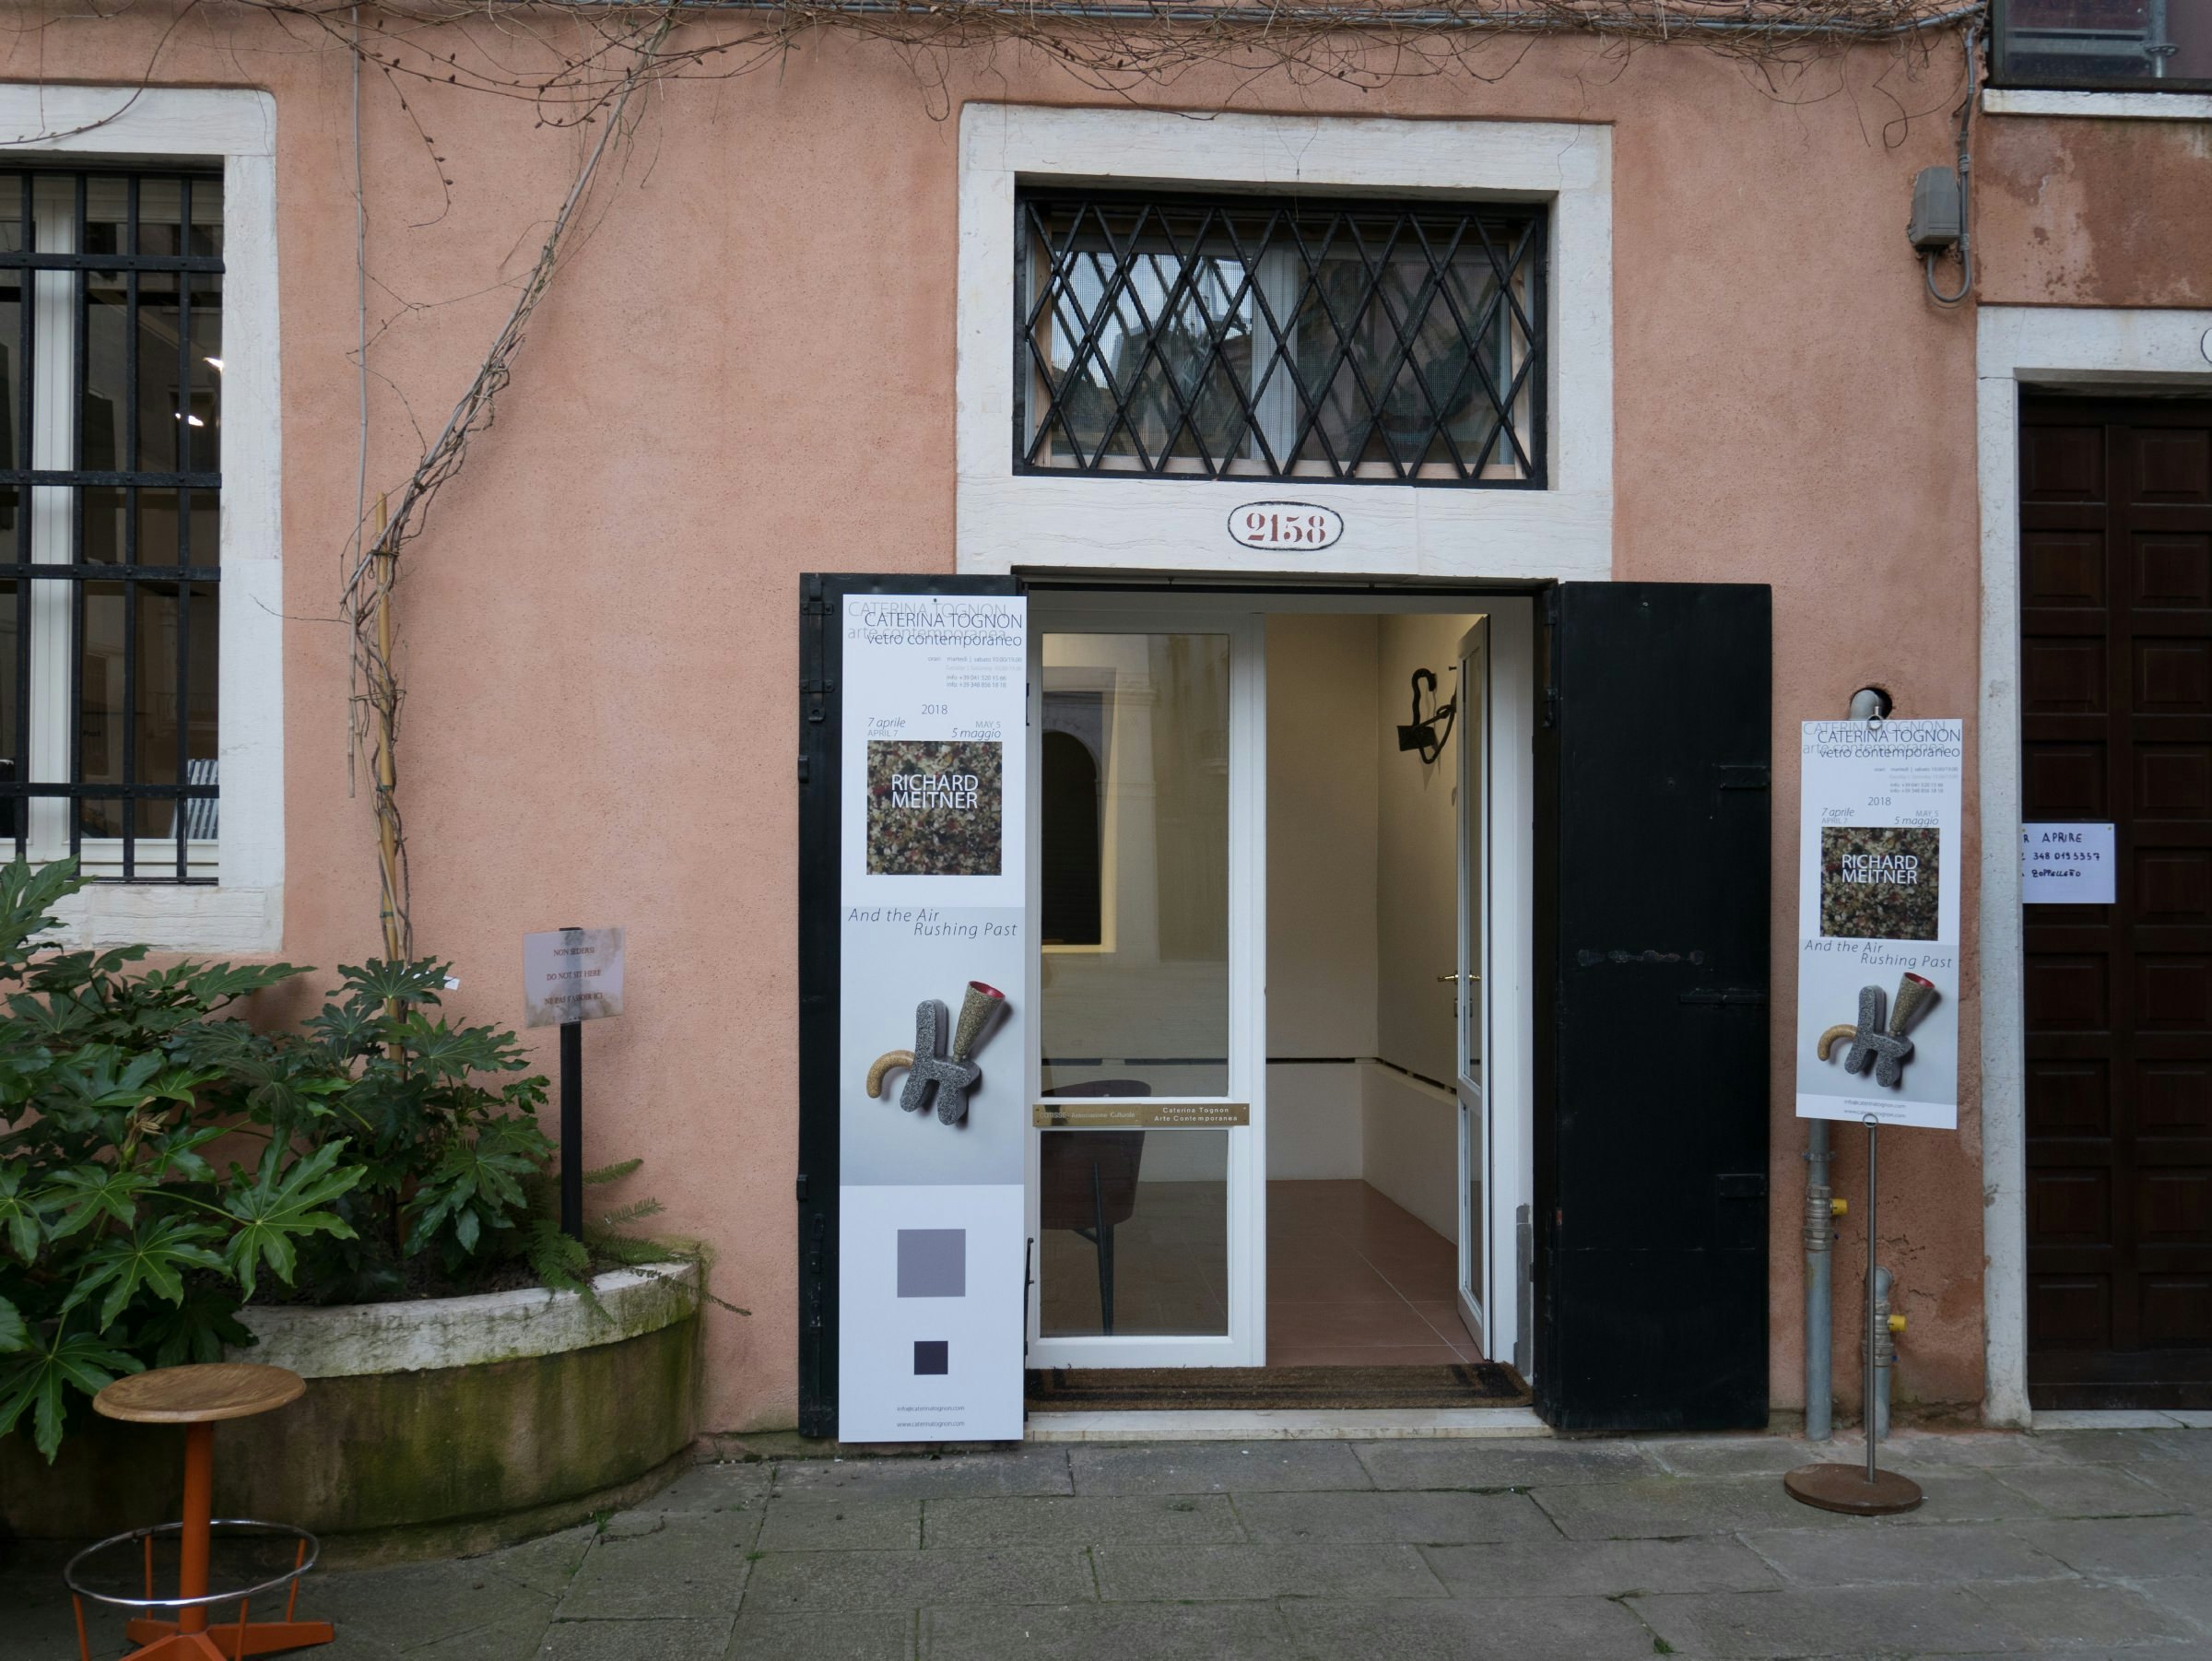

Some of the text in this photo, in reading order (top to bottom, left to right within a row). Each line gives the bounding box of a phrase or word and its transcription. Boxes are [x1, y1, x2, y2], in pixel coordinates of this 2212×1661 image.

[1246, 512, 1325, 543] 2158
[865, 612, 1022, 629] CATERINA TOGNON
[867, 633, 1022, 648] vetro contemporaneo
[922, 704, 947, 715] 2018
[867, 717, 906, 729] 7 aprile
[951, 728, 1001, 741] 5 maggio
[1818, 729, 1960, 743] CATERINA TOGNON
[1819, 748, 1959, 760] vetro contemporaneo
[891, 774, 979, 792] RICHARD
[891, 791, 978, 808] MEITNER
[1867, 796, 1891, 806] 2018
[1821, 807, 1854, 818] 7 aprile
[1901, 817, 1939, 827] maggio
[2042, 832, 2082, 842] APRIRE
[1841, 854, 1918, 869] RICHARD
[1841, 869, 1918, 885] MEITNER
[848, 908, 940, 922] And the Air
[914, 922, 1018, 939] Rushing Past
[553, 948, 569, 957] NON
[1804, 939, 1883, 953] And the Air
[1860, 953, 1952, 969] Rushing Past
[559, 972, 571, 980] NOT
[573, 971, 582, 979] SIT
